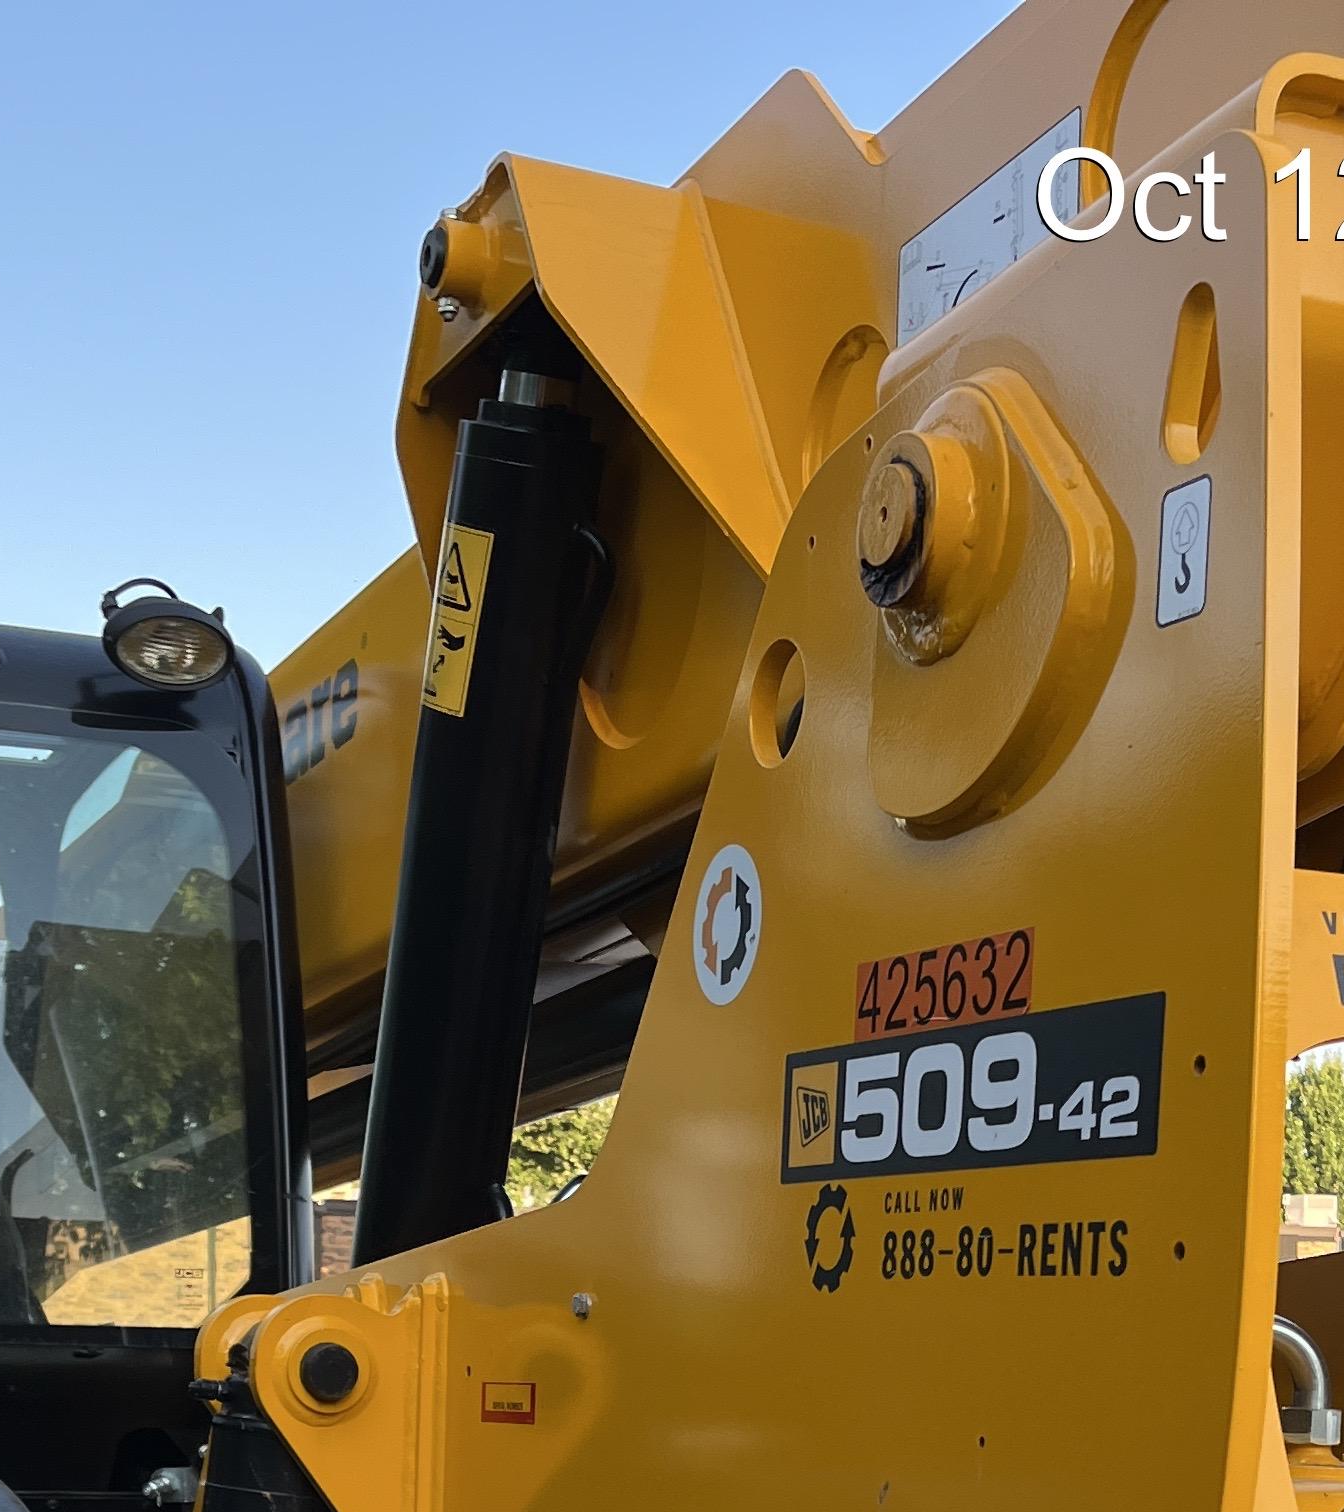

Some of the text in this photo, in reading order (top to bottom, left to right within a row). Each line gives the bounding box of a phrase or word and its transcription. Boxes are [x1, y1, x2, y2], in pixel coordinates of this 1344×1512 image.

[857, 929, 1031, 1034] 425632
[799, 1091, 829, 1142] JCB
[840, 1031, 1141, 1164] 509-42
[883, 1186, 965, 1214] CALL NOW
[881, 1219, 1129, 1281] 888-80-RENTS
